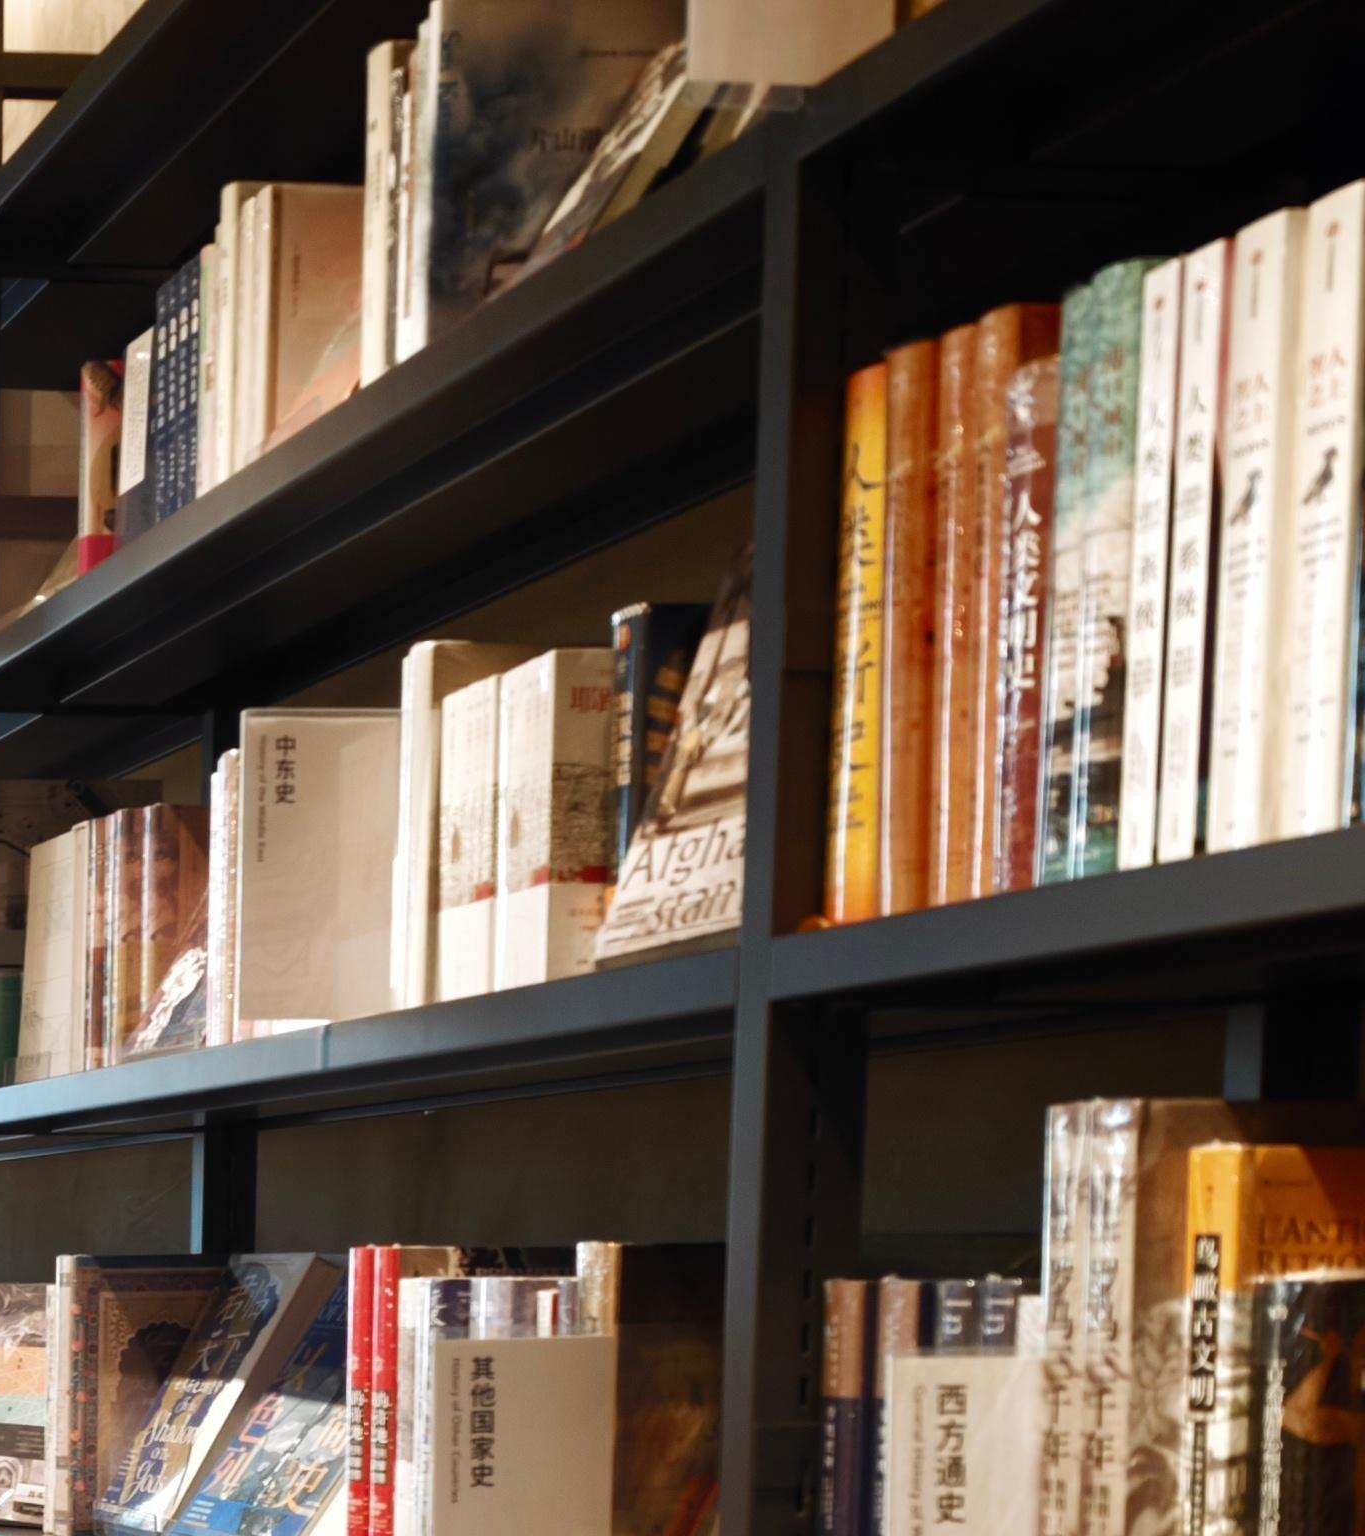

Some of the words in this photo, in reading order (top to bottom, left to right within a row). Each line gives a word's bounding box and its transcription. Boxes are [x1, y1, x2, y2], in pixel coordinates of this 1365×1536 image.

[274, 735, 297, 804] 中东史
[469, 1356, 497, 1489] 其他国家史
[935, 1384, 968, 1525] 西方通史
